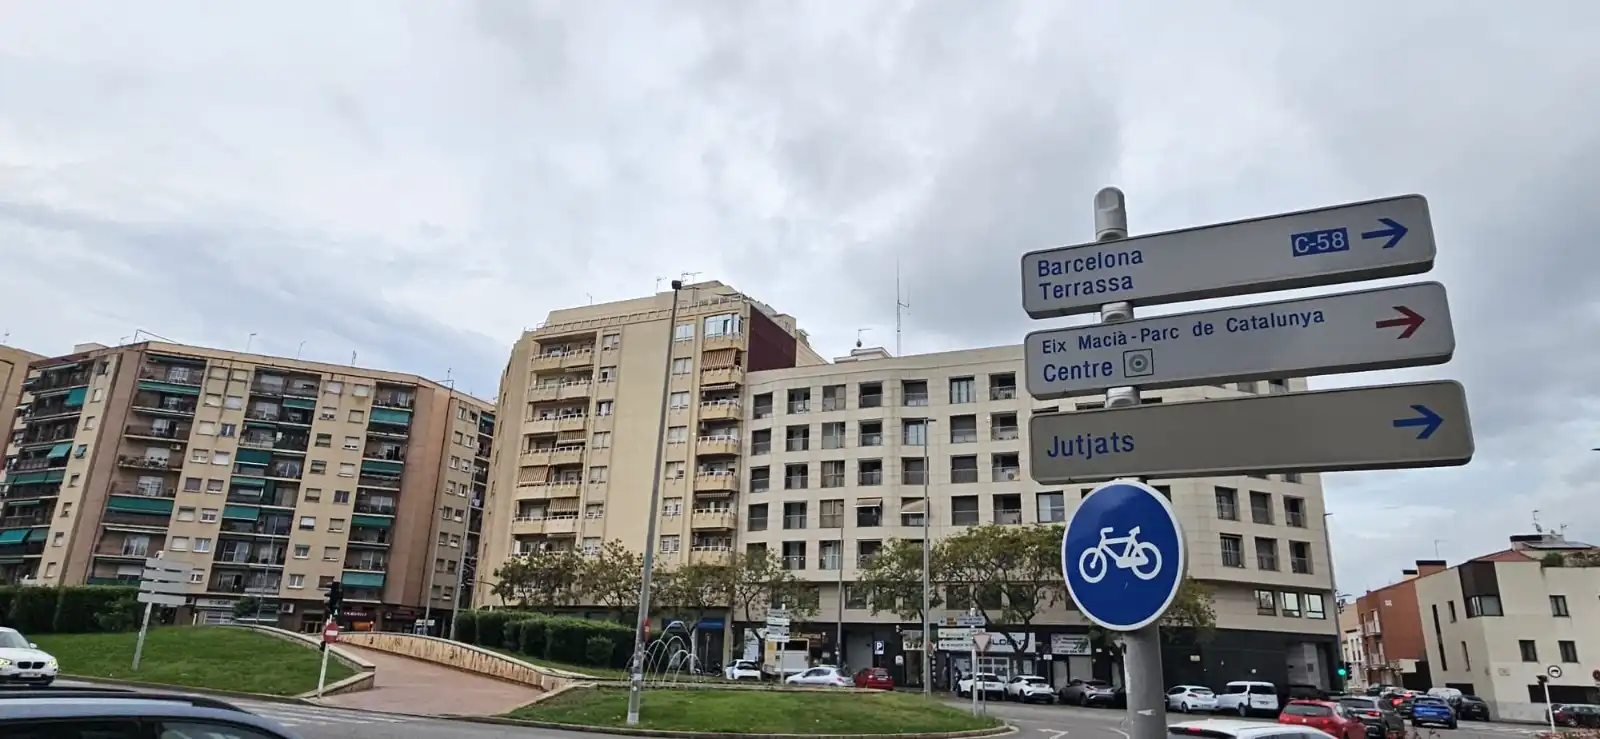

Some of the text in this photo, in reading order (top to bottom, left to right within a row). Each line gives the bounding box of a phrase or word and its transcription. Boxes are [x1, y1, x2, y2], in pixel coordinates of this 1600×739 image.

[1295, 231, 1345, 253] C-58
[1037, 249, 1144, 278] Barcelona
[1038, 275, 1134, 300] Terrassa
[1042, 339, 1067, 354] Eix
[1192, 320, 1214, 337] de
[1226, 308, 1325, 333] Catalunya
[1043, 360, 1113, 383] Centre
[1047, 431, 1135, 460] Jutjats
